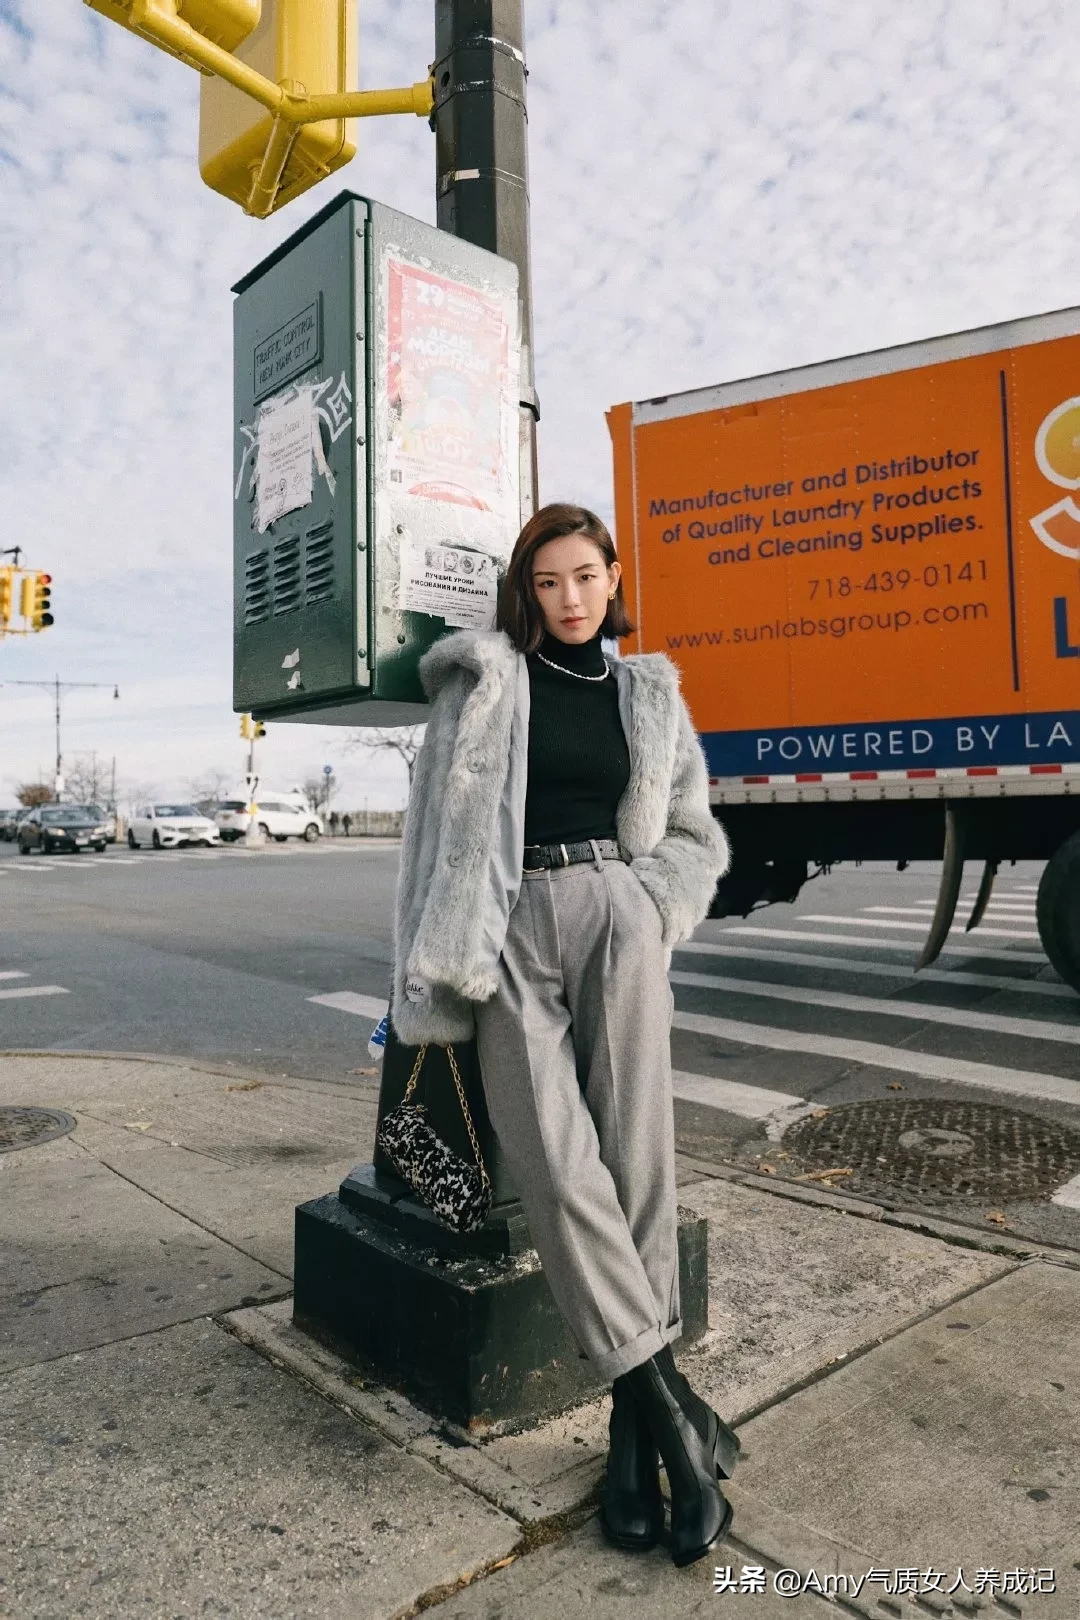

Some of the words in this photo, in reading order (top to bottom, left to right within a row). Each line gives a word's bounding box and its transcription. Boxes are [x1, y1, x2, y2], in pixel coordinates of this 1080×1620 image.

[256, 339, 282, 367] TRAFFIC
[283, 315, 315, 346] CONTROL
[259, 362, 274, 384] NEW
[276, 350, 292, 372] YORK
[294, 337, 311, 359] CITY
[648, 480, 794, 518] Manufacturer
[801, 468, 847, 494] and
[856, 450, 980, 484] Distributor
[662, 524, 681, 544] of
[688, 514, 764, 540] Quality
[773, 499, 864, 527] Laundry
[873, 479, 982, 512] Products
[708, 543, 750, 565] and
[758, 531, 863, 559] Cleaning
[871, 514, 984, 545] Supplies.
[411, 579, 451, 592] РИСОВАНИЯ
[425, 572, 453, 582] ЛУЧШИЕ
[453, 577, 475, 586] УРОКИ
[807, 560, 988, 601] 718-439-0141
[666, 602, 988, 649] www.sunlabsgroup.com
[757, 729, 933, 761] POWERED
[957, 724, 1000, 751] BY
[1025, 722, 1072, 749] LA
